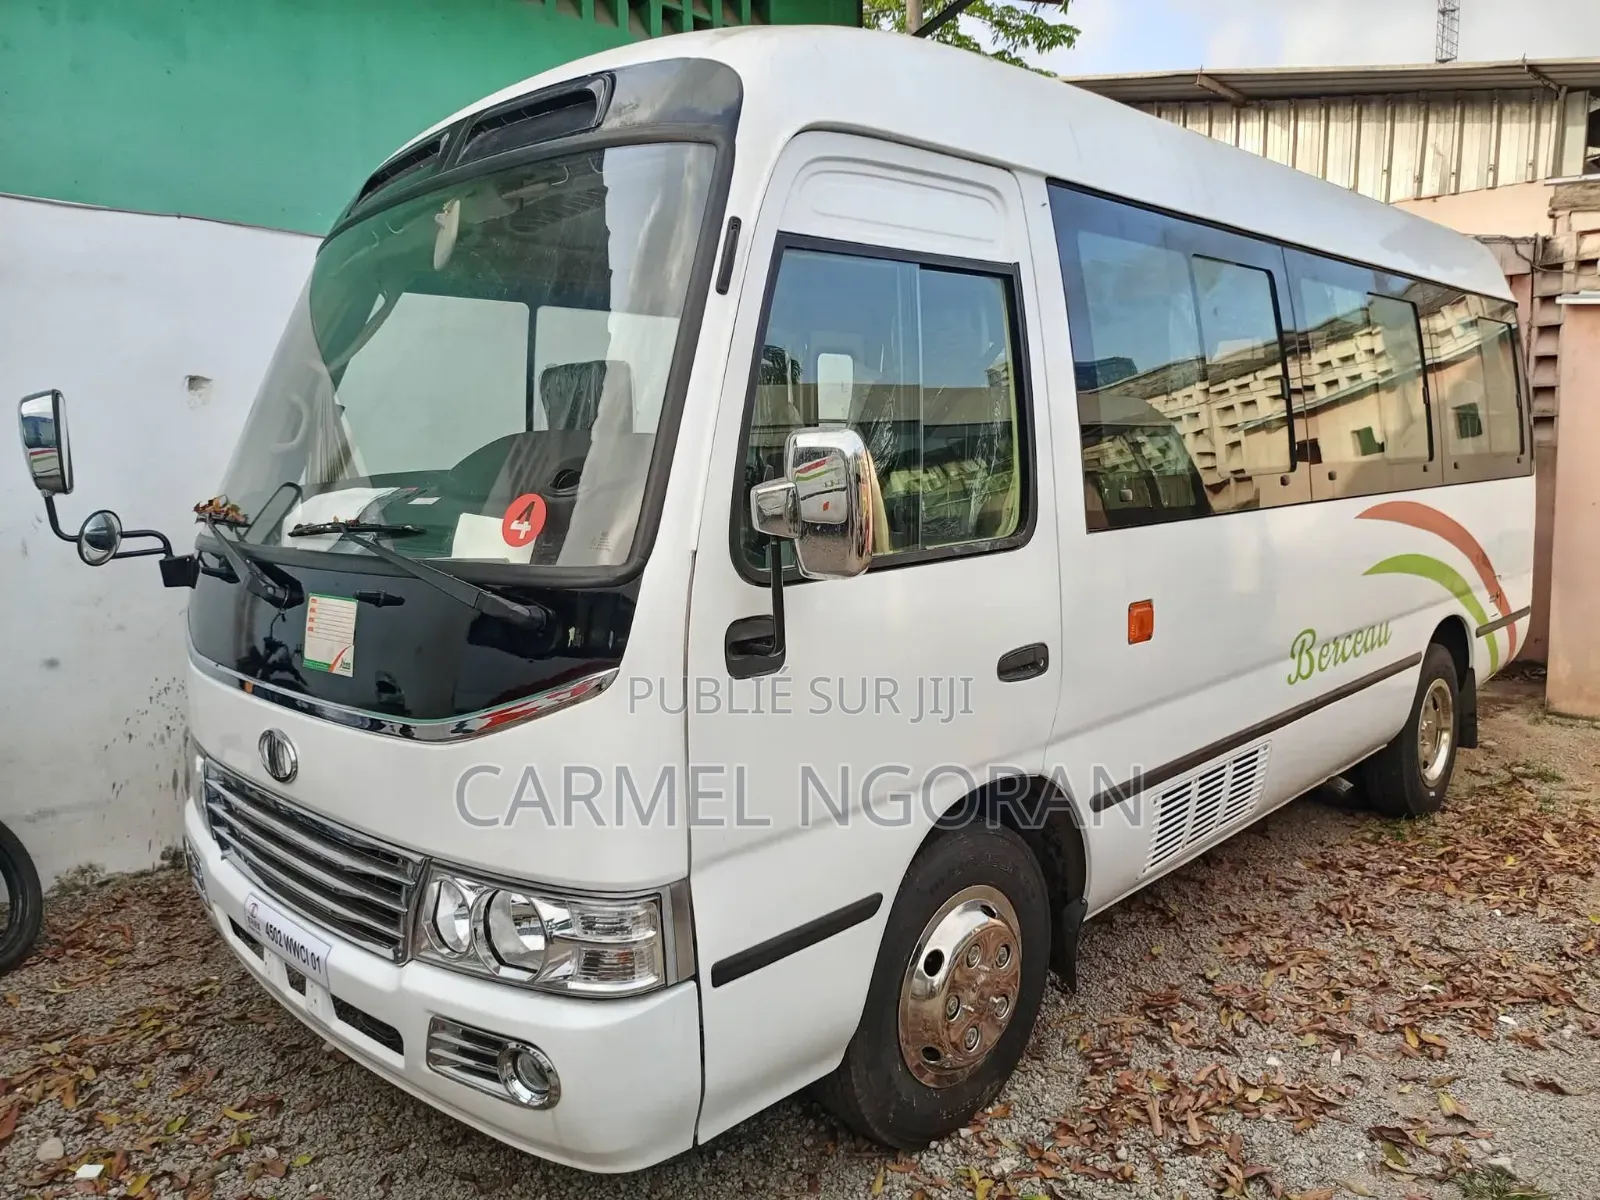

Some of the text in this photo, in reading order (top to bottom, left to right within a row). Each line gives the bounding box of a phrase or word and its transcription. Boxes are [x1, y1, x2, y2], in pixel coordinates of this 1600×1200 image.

[509, 501, 536, 540] 4
[1287, 620, 1392, 685] Berceau
[265, 921, 283, 948] 4502
